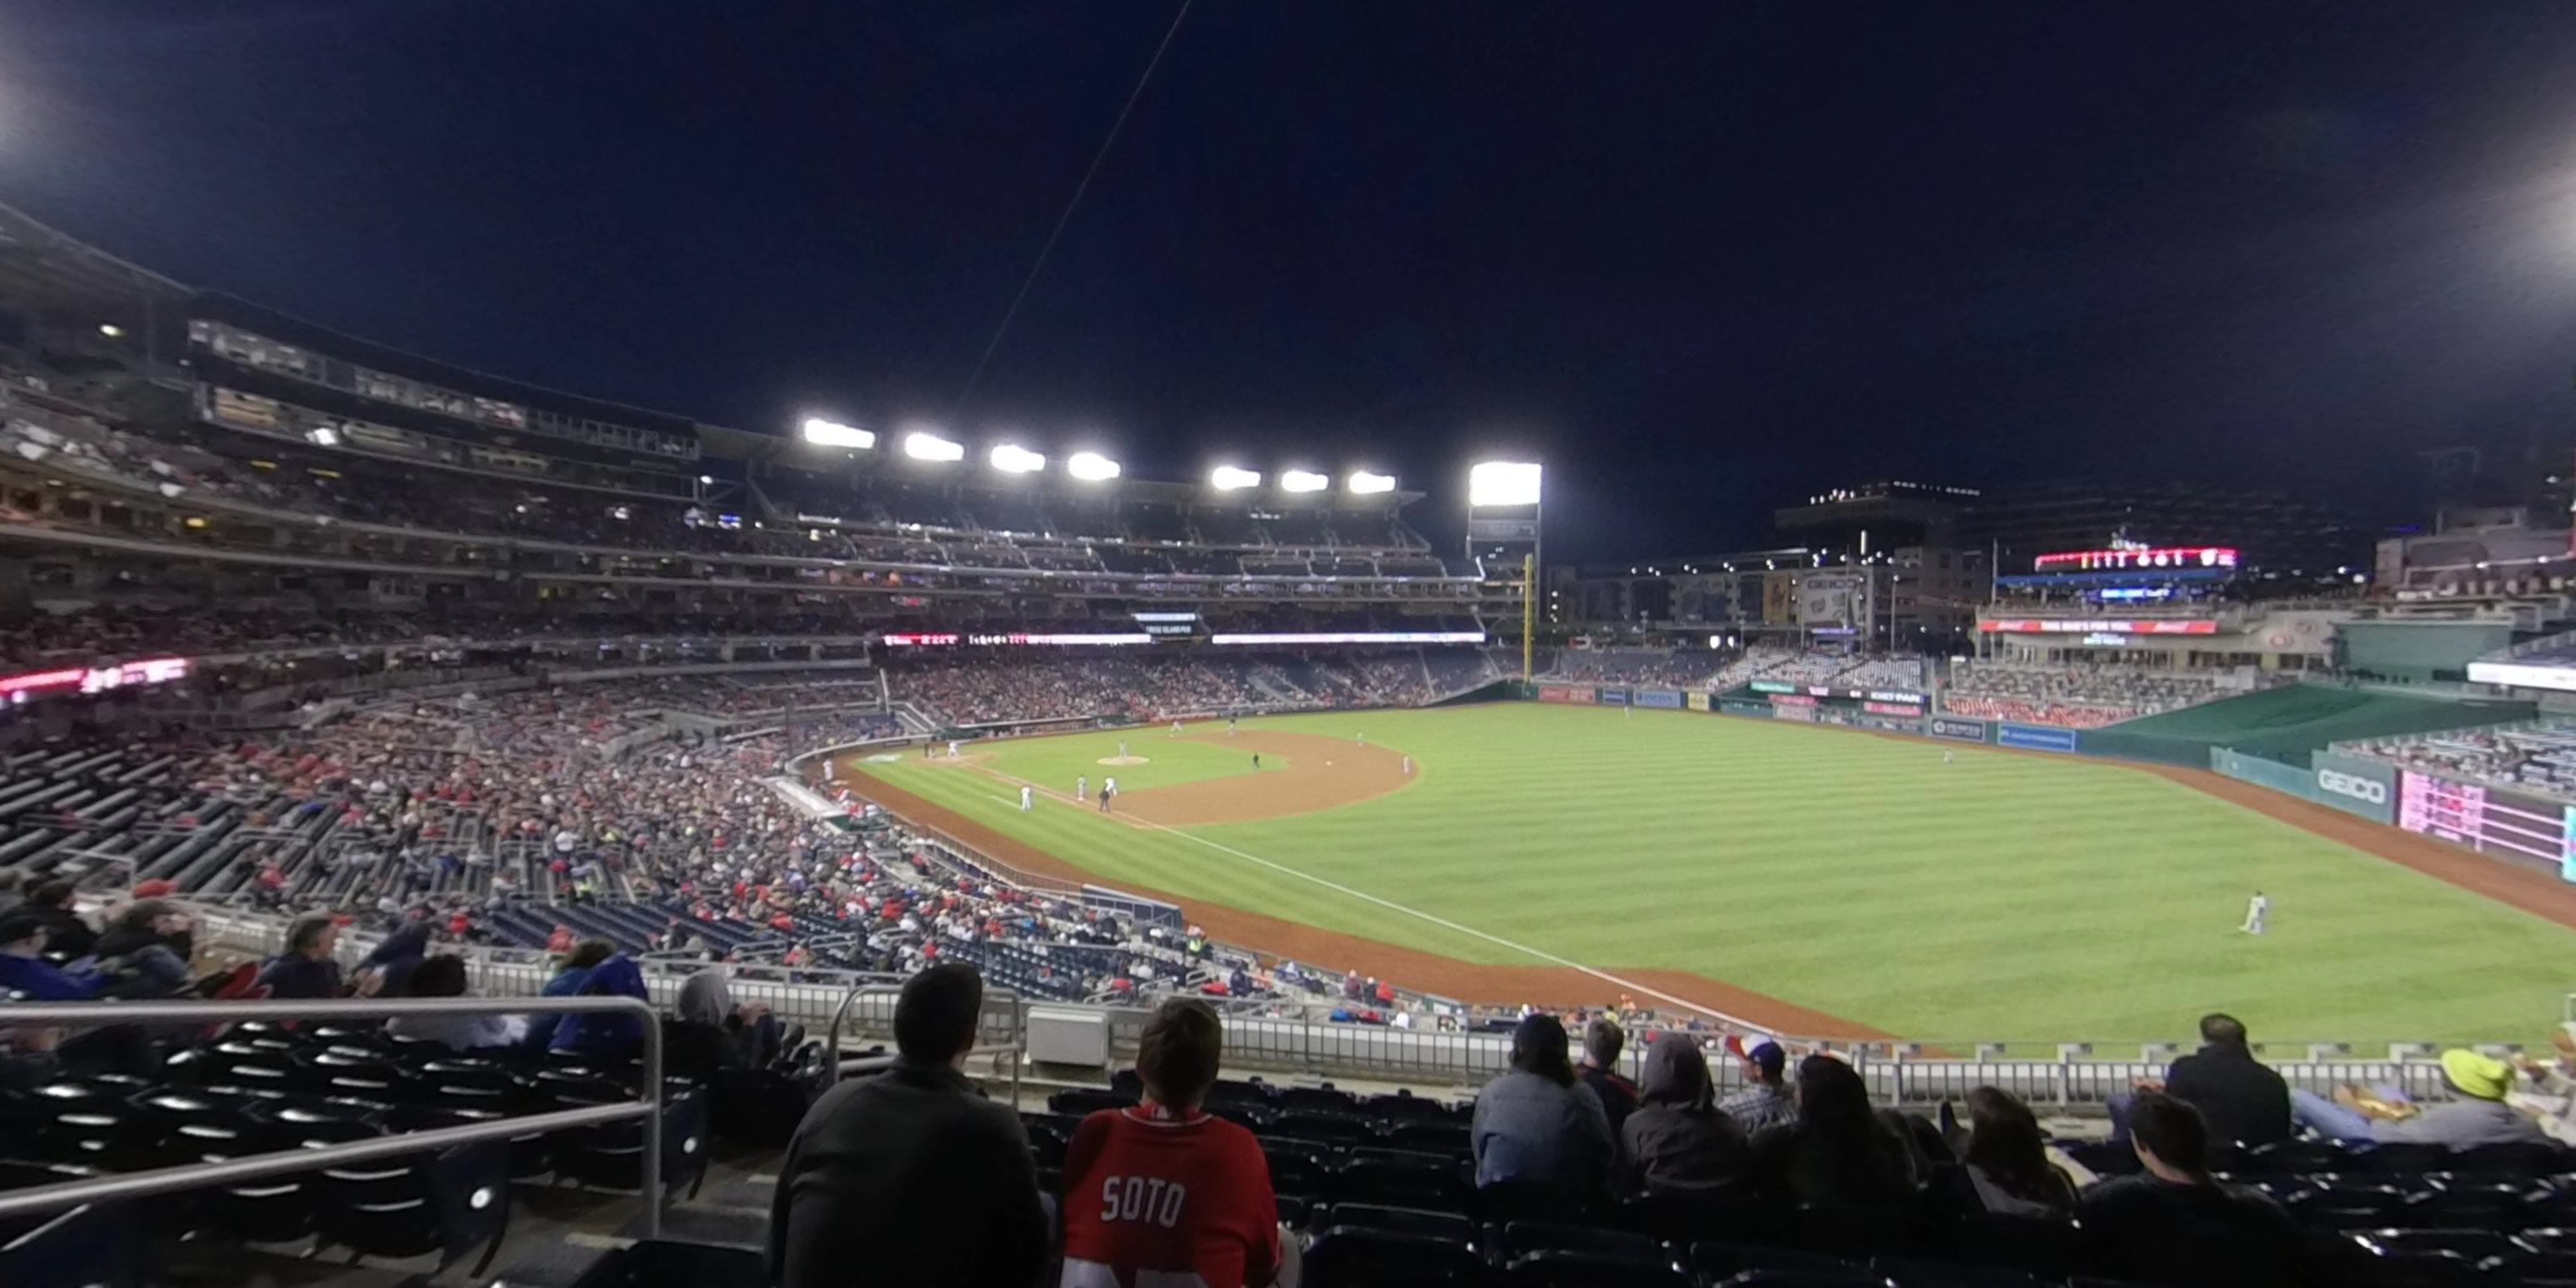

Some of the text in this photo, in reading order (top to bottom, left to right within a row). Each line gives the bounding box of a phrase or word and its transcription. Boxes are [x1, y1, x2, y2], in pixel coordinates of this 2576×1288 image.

[1807, 579, 1857, 590] GEICO
[2318, 769, 2386, 805] GEICO
[1101, 1174, 1185, 1228] SOTO
